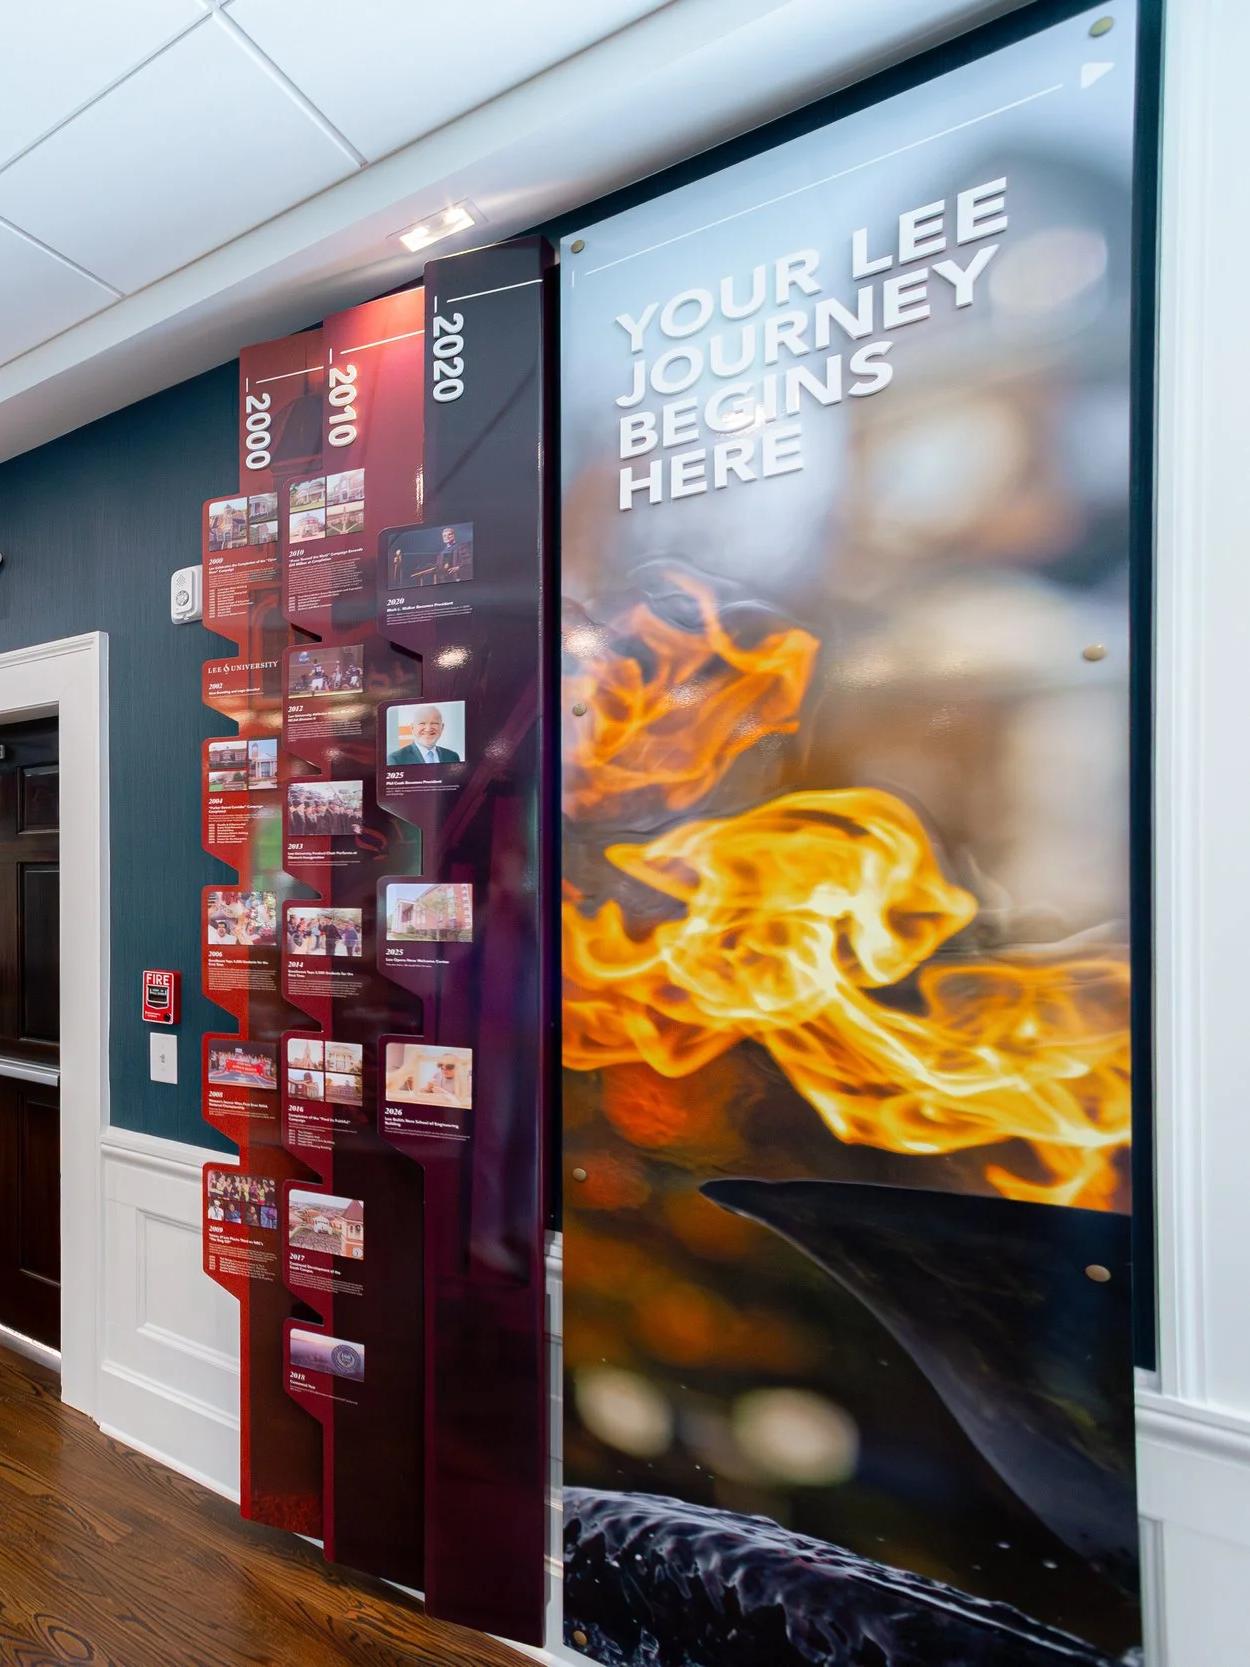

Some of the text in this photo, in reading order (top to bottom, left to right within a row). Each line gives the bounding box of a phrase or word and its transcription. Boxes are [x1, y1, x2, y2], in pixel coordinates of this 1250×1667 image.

[615, 176, 1008, 354] YOUR LEE
[615, 243, 1000, 410] JOURNEY
[432, 312, 464, 403] 2020
[328, 364, 358, 448] 2010
[619, 340, 894, 459] BEGINS
[245, 392, 272, 471] 2000
[619, 423, 805, 511] HERE
[288, 549, 305, 558] 2010
[386, 598, 405, 606] 2020
[231, 661, 278, 671] UNIVERSITY
[385, 948, 404, 956] 2025
[146, 973, 170, 986] FIRE
[384, 1107, 402, 1115] 2026
[290, 1253, 305, 1261] 2017
[290, 1371, 306, 1381] 2018
